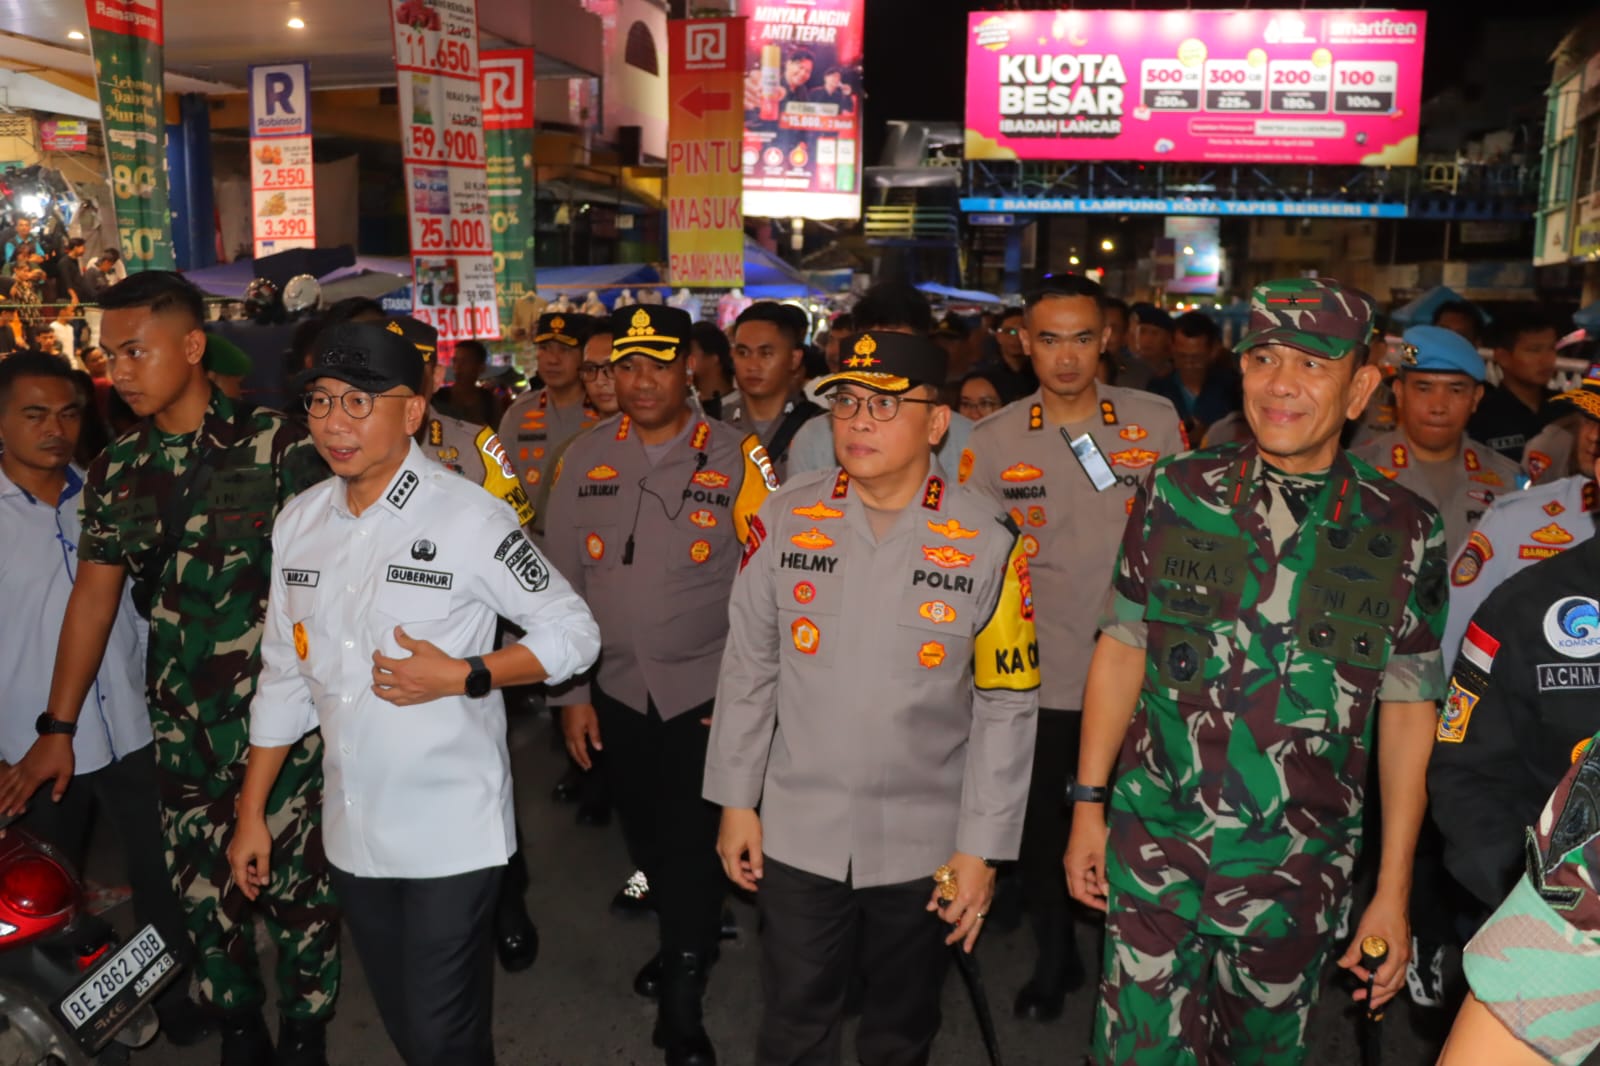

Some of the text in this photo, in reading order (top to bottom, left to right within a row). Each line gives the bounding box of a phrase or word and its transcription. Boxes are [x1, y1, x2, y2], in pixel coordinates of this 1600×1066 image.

[754, 6, 850, 27] MINYAK ANGIN
[761, 24, 837, 43] ANTI TEPAR
[407, 34, 470, 72] 11.650
[999, 54, 1128, 84] KUOTA
[1146, 69, 1183, 83] 500
[1209, 69, 1247, 84] 300
[1273, 70, 1311, 84] 200
[1340, 70, 1375, 85] 100
[999, 85, 1124, 115] BESAR
[258, 117, 302, 127] Robinson
[1000, 119, 1121, 134] IBADAH LANCAR
[412, 126, 477, 160] 59.900
[670, 140, 742, 175] PINTU
[263, 168, 305, 186] 2.550
[670, 197, 742, 231] MASUK
[1003, 199, 1362, 214] BANDAR LAMPUNG KOTA TAPIS BERSERI
[265, 219, 307, 235] 3.390
[421, 218, 485, 248] 25.000
[670, 253, 743, 281] RAMAYANA
[437, 306, 492, 337] 50.000
[682, 489, 730, 508] POLRI
[780, 552, 838, 573] HELMY
[1164, 556, 1235, 586] RIKAS
[391, 569, 448, 586] GUBERNUR
[912, 570, 974, 594] POLRI
[1311, 585, 1390, 618] TNI AD
[996, 647, 1024, 674] KA
[70, 992, 97, 1021] BE
[93, 958, 133, 1001] 2862
